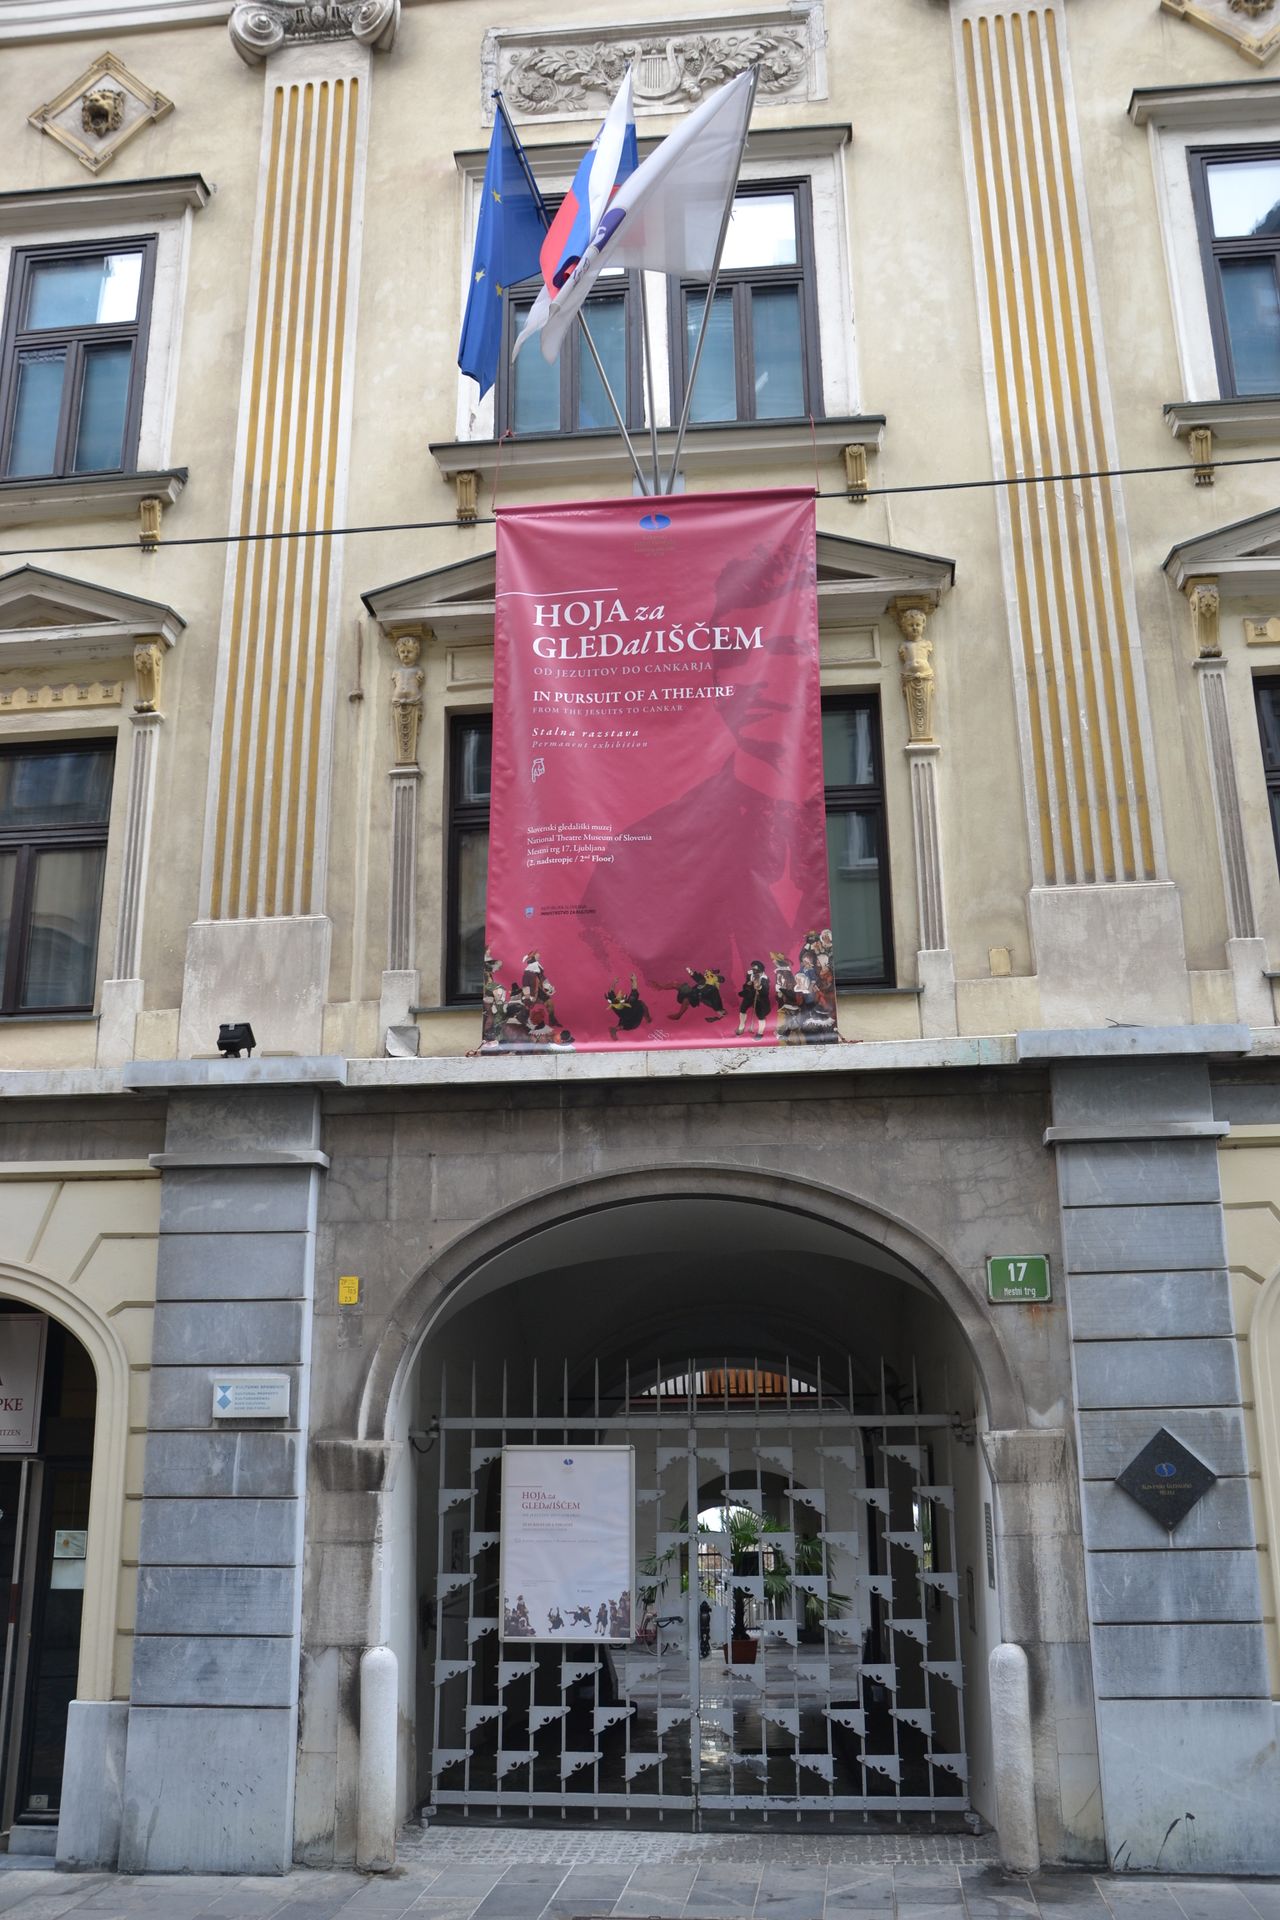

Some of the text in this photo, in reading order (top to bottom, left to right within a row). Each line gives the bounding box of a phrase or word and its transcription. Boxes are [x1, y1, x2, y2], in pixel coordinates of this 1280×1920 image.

[533, 599, 665, 631] HOJA za
[534, 662, 713, 679] OD JEZUITOV DO CANKARJA
[533, 685, 735, 705] IN PURSUIT OF A THEATRE
[533, 706, 560, 714] FROM
[563, 708, 582, 716] THE
[584, 708, 624, 717] JESUITS
[642, 704, 684, 713] CANKAR
[532, 726, 639, 738] Stalna razstava
[532, 740, 648, 749] Permanent exhibition
[527, 823, 557, 834] Slovenski
[591, 823, 612, 831] muzej
[557, 834, 582, 842] Theatre
[583, 833, 613, 841] Museum
[614, 833, 622, 841] of
[623, 833, 652, 841] Slovenia
[527, 846, 549, 856] Mestni
[550, 846, 561, 854] trg
[573, 844, 606, 853] Ljubljana
[536, 855, 573, 865] nadstropje
[592, 854, 615, 863] Floor)
[1008, 1262, 1028, 1282] 17
[1004, 1287, 1037, 1298] Mestni trg
[522, 1491, 546, 1500] HOJA
